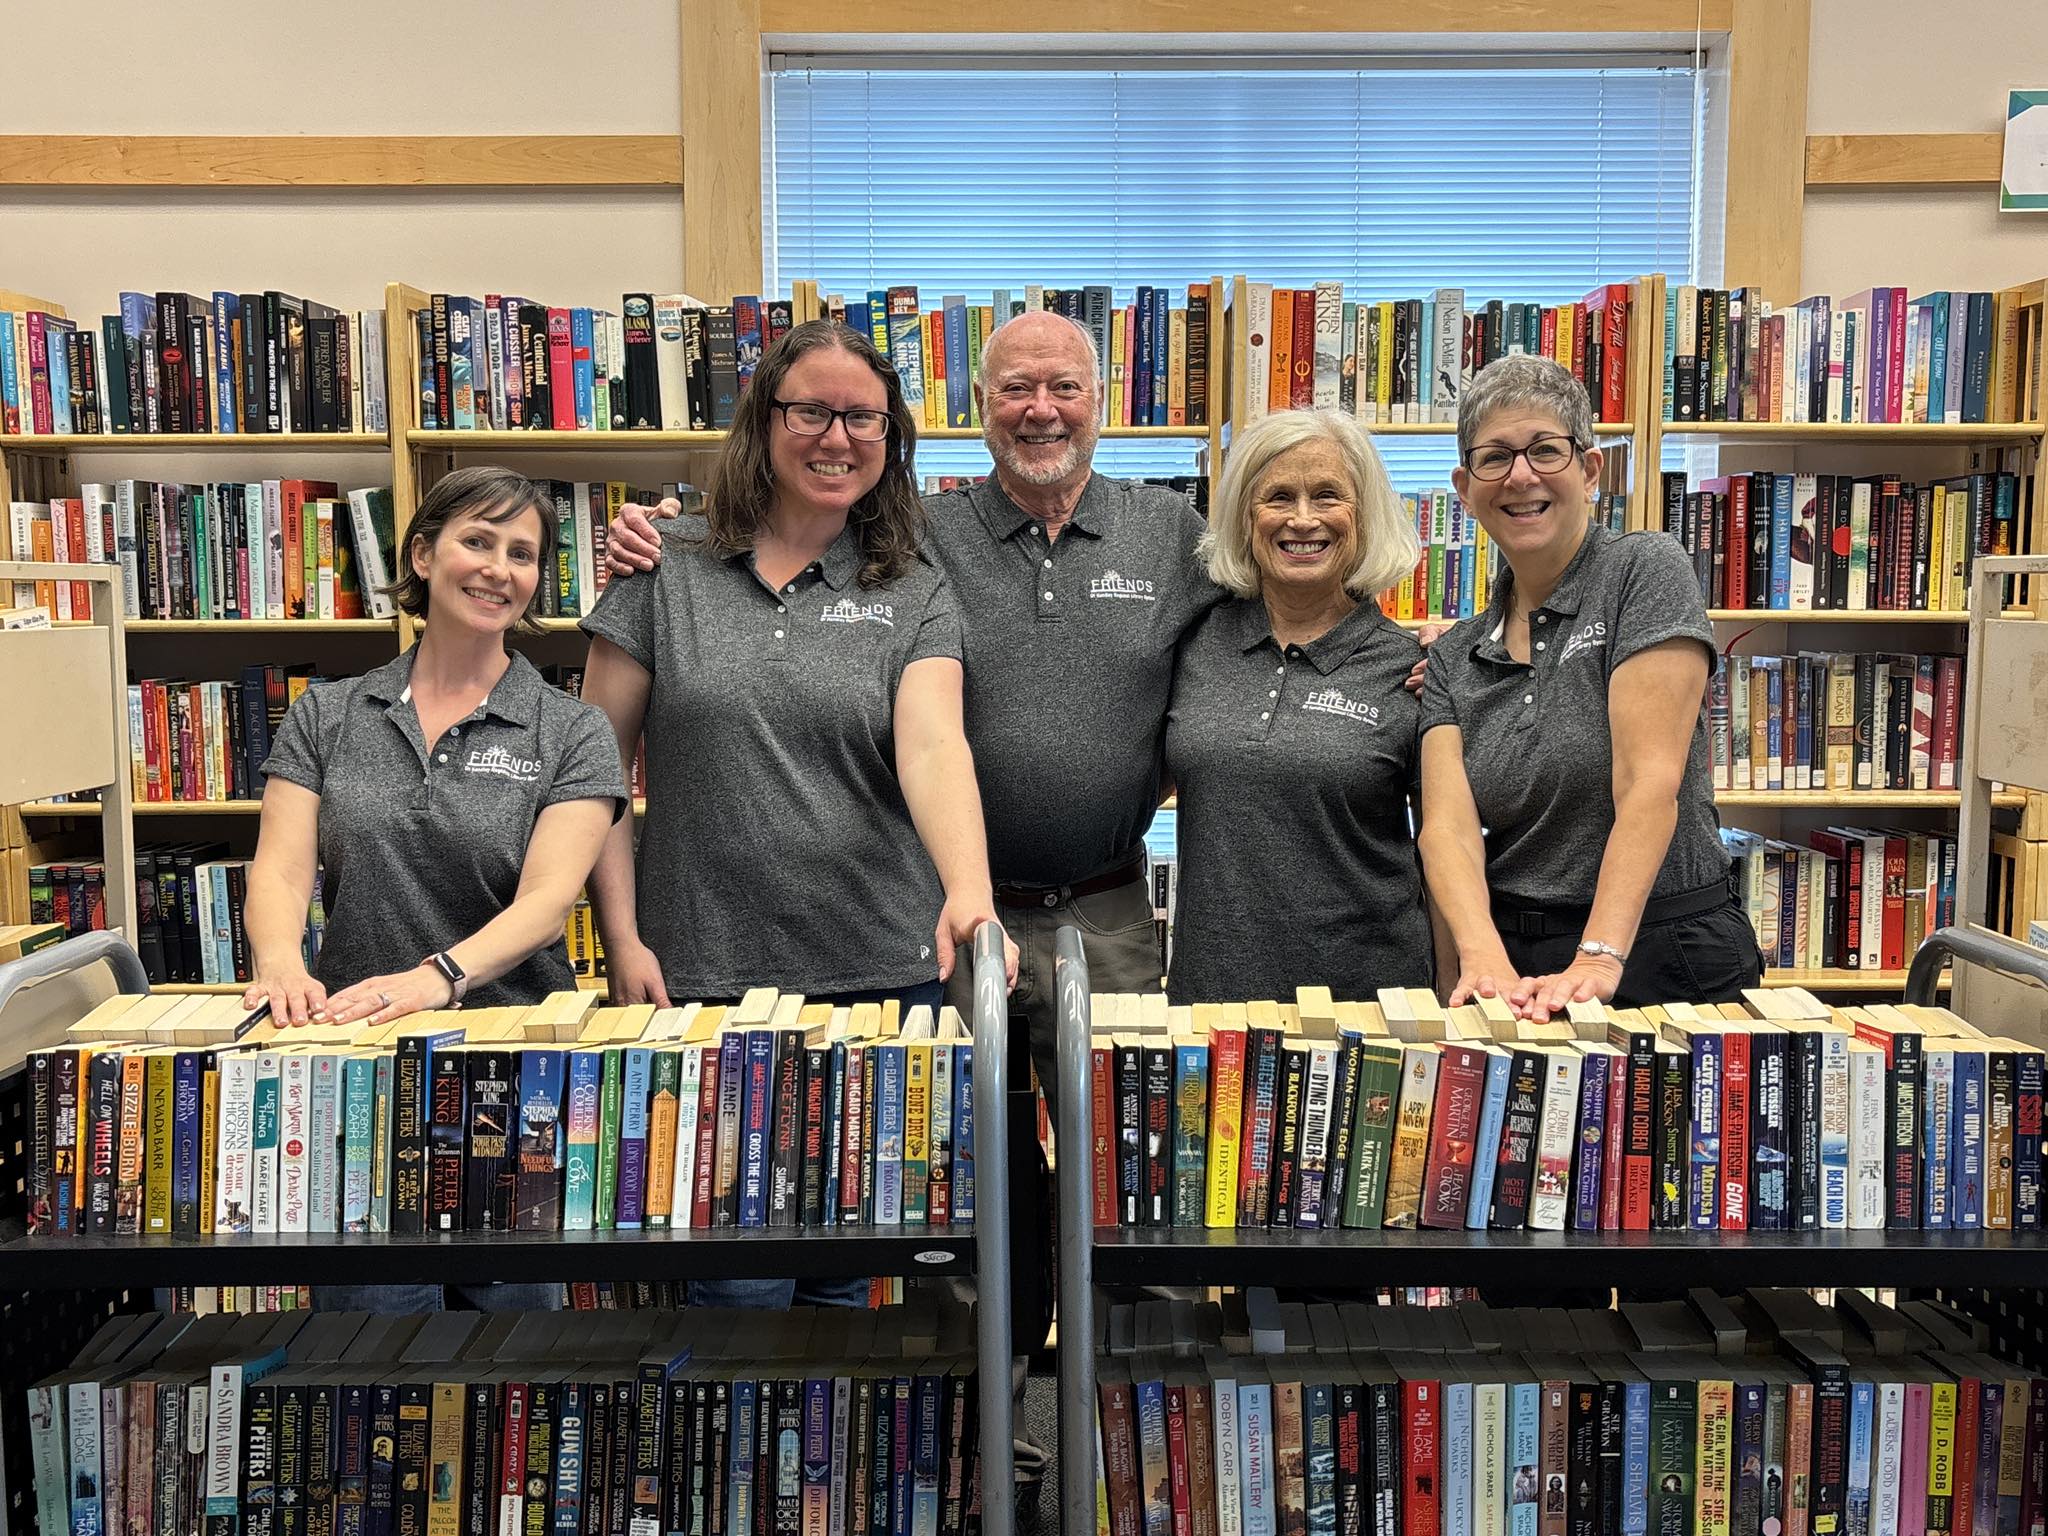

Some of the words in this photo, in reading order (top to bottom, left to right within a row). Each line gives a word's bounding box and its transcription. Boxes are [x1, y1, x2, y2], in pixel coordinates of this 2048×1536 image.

[433, 296, 446, 329] BRAD
[507, 301, 519, 325] CLIVE
[893, 297, 916, 306] DUMA
[894, 306, 909, 314] KEY
[1143, 290, 1152, 310] Mary
[1316, 286, 1332, 334] KING
[1331, 285, 1340, 335] STEPHEN
[1719, 295, 1728, 326] STUART
[624, 317, 651, 329] ALASKA
[1189, 321, 1206, 355] ANGELS
[1444, 306, 1457, 336] Nelson
[2002, 318, 2016, 346] Help
[435, 330, 448, 363] THOR
[472, 319, 483, 360] TWILIGHT
[508, 326, 520, 367] CUSSLER
[896, 341, 909, 368] KING
[1142, 342, 1151, 363] Clark
[1717, 326, 1727, 363] WOODS
[1833, 329, 1843, 357] prep
[907, 341, 920, 389] STEPHEN
[1700, 361, 1710, 378] Blue
[510, 401, 522, 425] SHIP
[610, 485, 621, 505] JOHN
[1701, 493, 1712, 522] BRAD
[1775, 479, 1790, 508] DAVID
[1420, 500, 1429, 543] MONK
[1434, 495, 1445, 538] MONK
[1451, 500, 1462, 543] MONK
[1700, 522, 1711, 551] THOR
[1091, 578, 1153, 592] FRIENDS
[823, 604, 893, 618] FRIENDS
[1307, 691, 1379, 718] FRIENDS
[1835, 679, 1846, 723] IRELAND
[470, 750, 541, 772] FRIENDS
[1784, 887, 1795, 908] LOST
[1782, 910, 1795, 947] STORIES
[400, 1058, 415, 1104] ELIZABETH
[474, 1080, 508, 1093] STEPHEN
[630, 1070, 643, 1097] ANNE
[779, 1056, 794, 1101] VINCE
[1701, 1054, 1715, 1086] CLIVE
[34, 1083, 48, 1127] DANIELLE
[101, 1079, 113, 1102] HELL
[266, 1089, 276, 1114] JUST
[435, 1077, 450, 1124] KING
[450, 1076, 461, 1124] STEPHEN
[482, 1091, 500, 1104] KING
[909, 1086, 925, 1116] BONE
[1215, 1065, 1229, 1117] TUROW
[1227, 1070, 1242, 1114] SCOTT
[1309, 1072, 1330, 1105] DYING
[1583, 1078, 1596, 1120] SCREAM
[1593, 1056, 1608, 1121] DEVONSHIRE
[1632, 1067, 1652, 1112] HARLAN
[100, 1104, 113, 1119] ON
[123, 1082, 139, 1131] SIZZLE
[153, 1087, 166, 1134] NEVADA
[257, 1104, 267, 1139] THING
[348, 1102, 360, 1139] CARR
[358, 1103, 370, 1139] ROBYN
[399, 1106, 414, 1138] PETERS
[522, 1105, 559, 1118] STEPHEN
[528, 1111, 552, 1123] KING
[628, 1102, 641, 1133] PERRY
[1402, 1115, 1425, 1129] NIVEN
[1403, 1101, 1427, 1114] LARRY
[1446, 1085, 1465, 1139] MARTIN
[1700, 1087, 1713, 1134] CUSSLER
[225, 1101, 237, 1151] HIGGINS
[237, 1101, 250, 1151] KRISTAN
[779, 1105, 791, 1153] FLYNN
[908, 1116, 924, 1141] DRY
[1303, 1108, 1327, 1157] THUNDER
[1631, 1114, 1650, 1151] COBEN
[1963, 1113, 1980, 1147] UTOPIA
[35, 1128, 48, 1165] STEEL
[93, 1119, 112, 1176] WHEELS
[120, 1138, 138, 1178] BURN
[152, 1138, 165, 1170] BARR
[747, 1133, 762, 1160] CROSS
[1359, 1138, 1375, 1173] MARK
[224, 1154, 235, 1196] dreams
[258, 1155, 268, 1189] MARIE
[433, 1157, 444, 1211] STRAUB
[444, 1158, 459, 1210] PETER
[567, 1156, 582, 1193] COVE
[747, 1160, 761, 1176] THE
[1216, 1144, 1229, 1220] IDENTICAL
[1639, 1164, 1649, 1191] DEAL
[1826, 1169, 1844, 1200] BEACH
[397, 1169, 406, 1210] CROWN
[409, 1167, 417, 1212] SERPENT
[746, 1177, 760, 1198] LINE
[774, 1167, 787, 1211] SURVIVOR
[785, 1181, 795, 1195] THE
[1357, 1173, 1370, 1208] TWAIN
[1627, 1164, 1640, 1214] BREAKER
[1700, 1164, 1716, 1216] MEDUSA
[1725, 1182, 1744, 1223] GONE
[258, 1191, 267, 1226] HARTE
[1826, 1200, 1844, 1224] ROAD
[217, 1388, 235, 1445] SANDRA
[1220, 1393, 1233, 1437] ROBYN
[1600, 1400, 1612, 1447] GRAFTON
[1610, 1413, 1621, 1434] SUE
[1716, 1404, 1727, 1420] THE
[560, 1416, 582, 1455] GUN
[1247, 1413, 1261, 1453] SUSAN
[1412, 1428, 1424, 1464] HOAG
[1422, 1432, 1433, 1465] TAMI
[1517, 1430, 1526, 1462] HAVEN
[1524, 1434, 1534, 1457] SAFE
[1629, 1425, 1644, 1460] JILL
[1703, 1413, 1715, 1451] DRAGON
[1716, 1420, 1727, 1447] GIRL
[1935, 1438, 1948, 1451] D.
[213, 1446, 233, 1495] BROWN
[558, 1459, 579, 1493] SHY
[1221, 1442, 1235, 1478] CARR
[1702, 1452, 1714, 1488] TATTOO
[1714, 1448, 1726, 1472] WITH
[1935, 1453, 1948, 1491] ROBB
[1248, 1457, 1263, 1510] MALLERY
[1628, 1463, 1643, 1526] SHALVIS
[1714, 1473, 1726, 1493] THE
